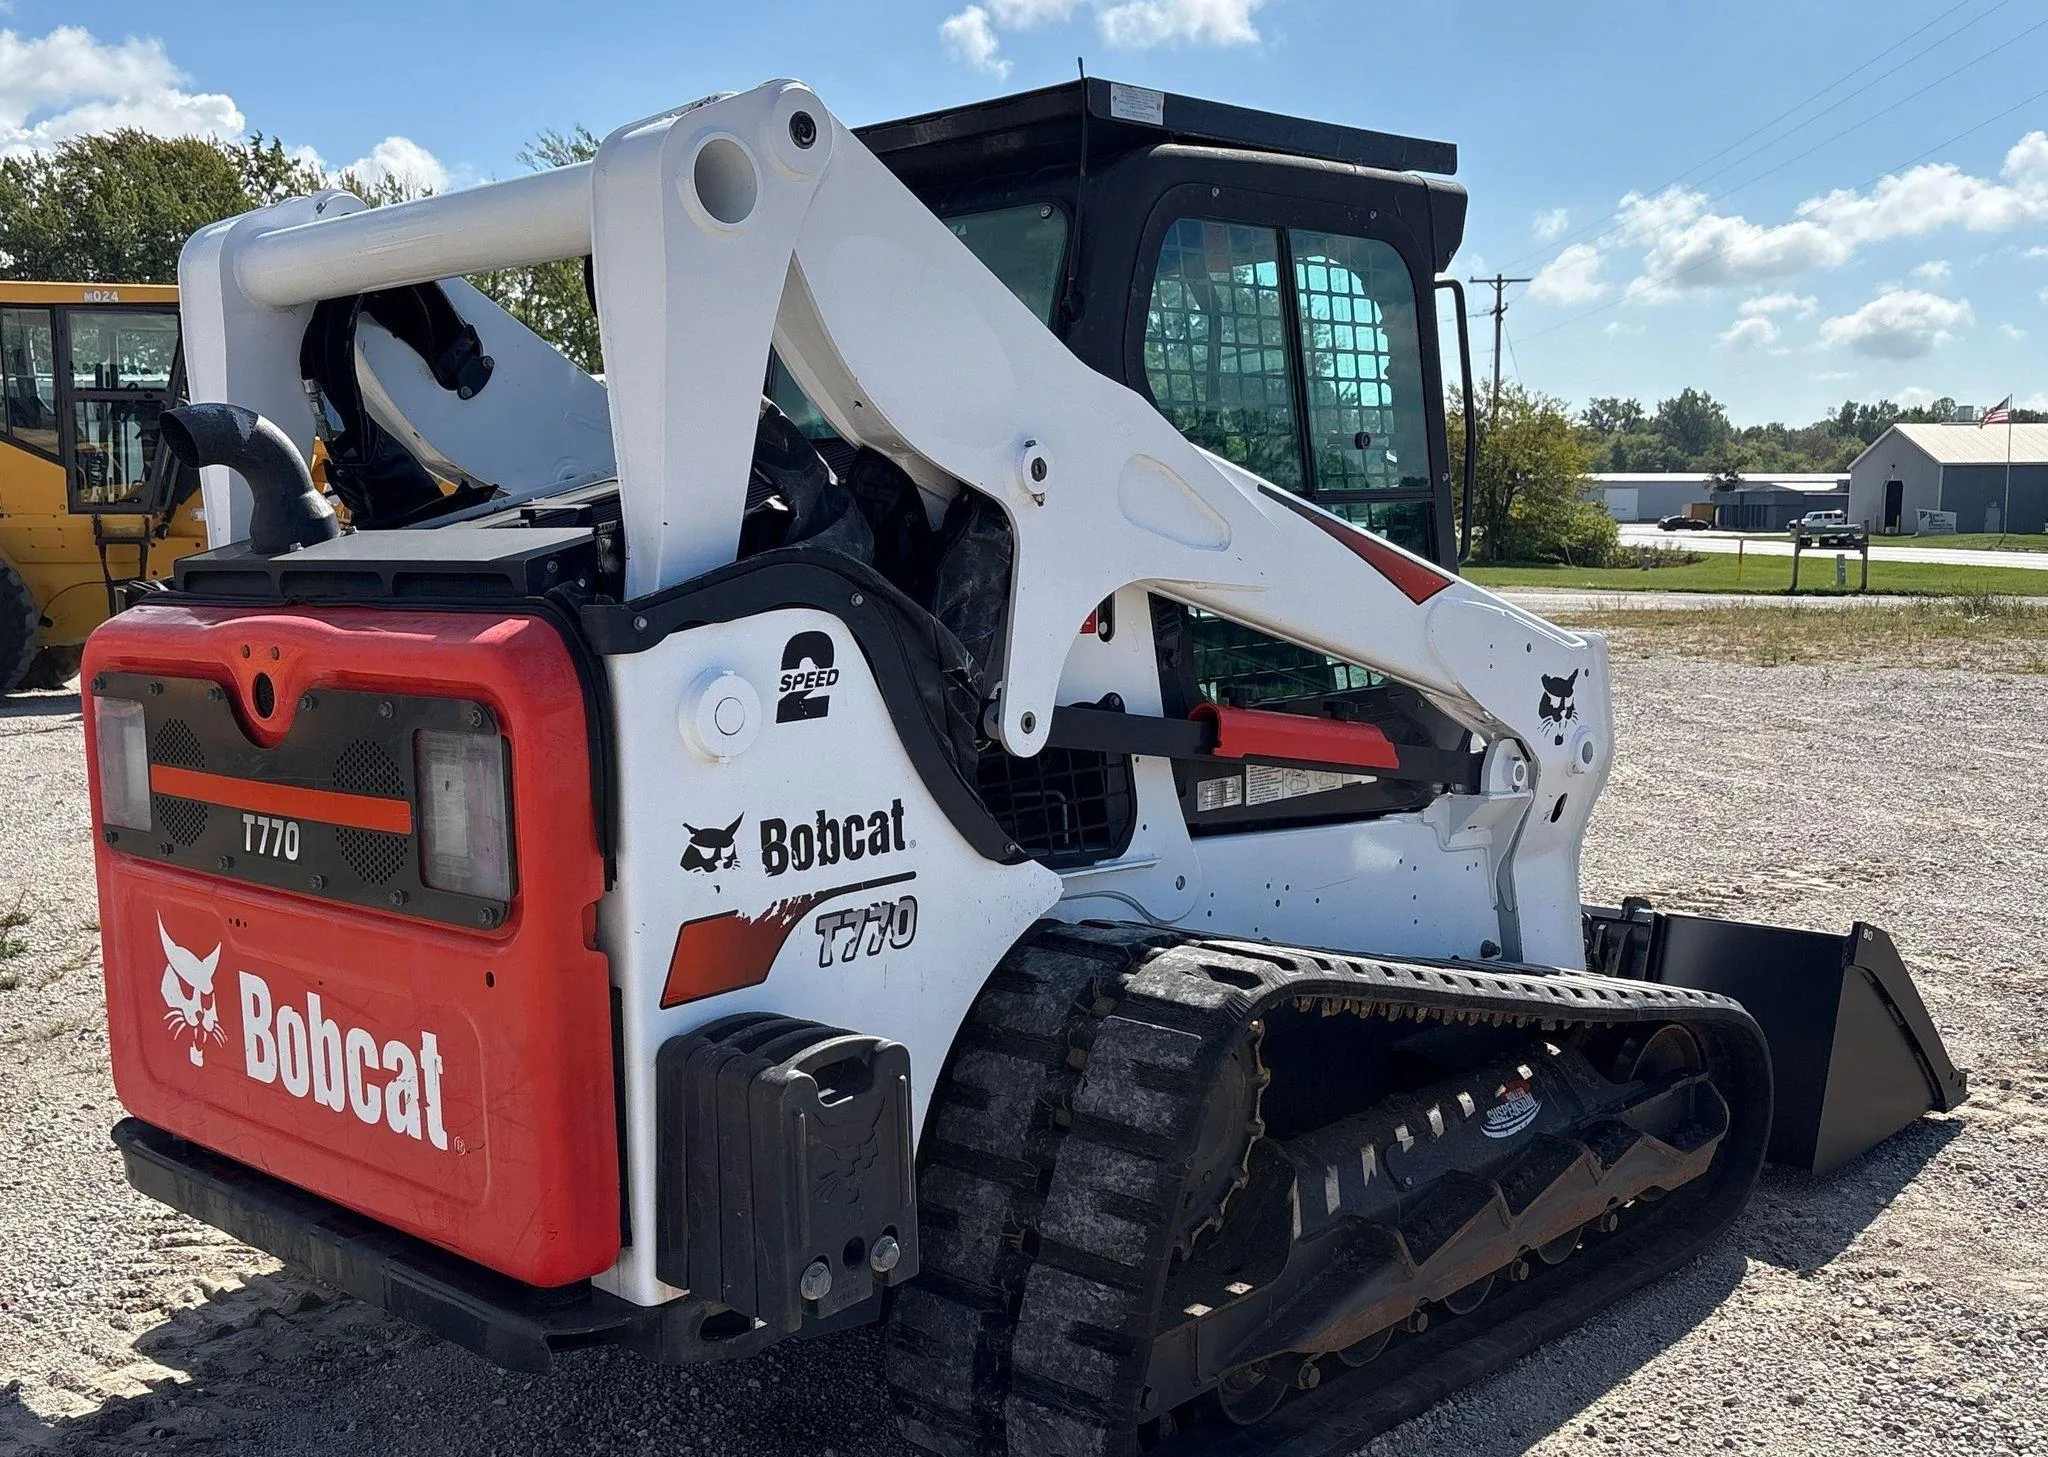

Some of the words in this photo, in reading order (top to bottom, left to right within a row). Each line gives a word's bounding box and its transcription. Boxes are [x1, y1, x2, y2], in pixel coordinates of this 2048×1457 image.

[84, 290, 119, 303] M024
[776, 631, 834, 723] 2
[779, 669, 839, 692] SPEED
[243, 813, 300, 861] T770
[760, 798, 906, 878] Bobcat
[815, 895, 918, 968] T770
[239, 970, 448, 1151] Bobcat
[1486, 1092, 1537, 1125] SUSPENSION
